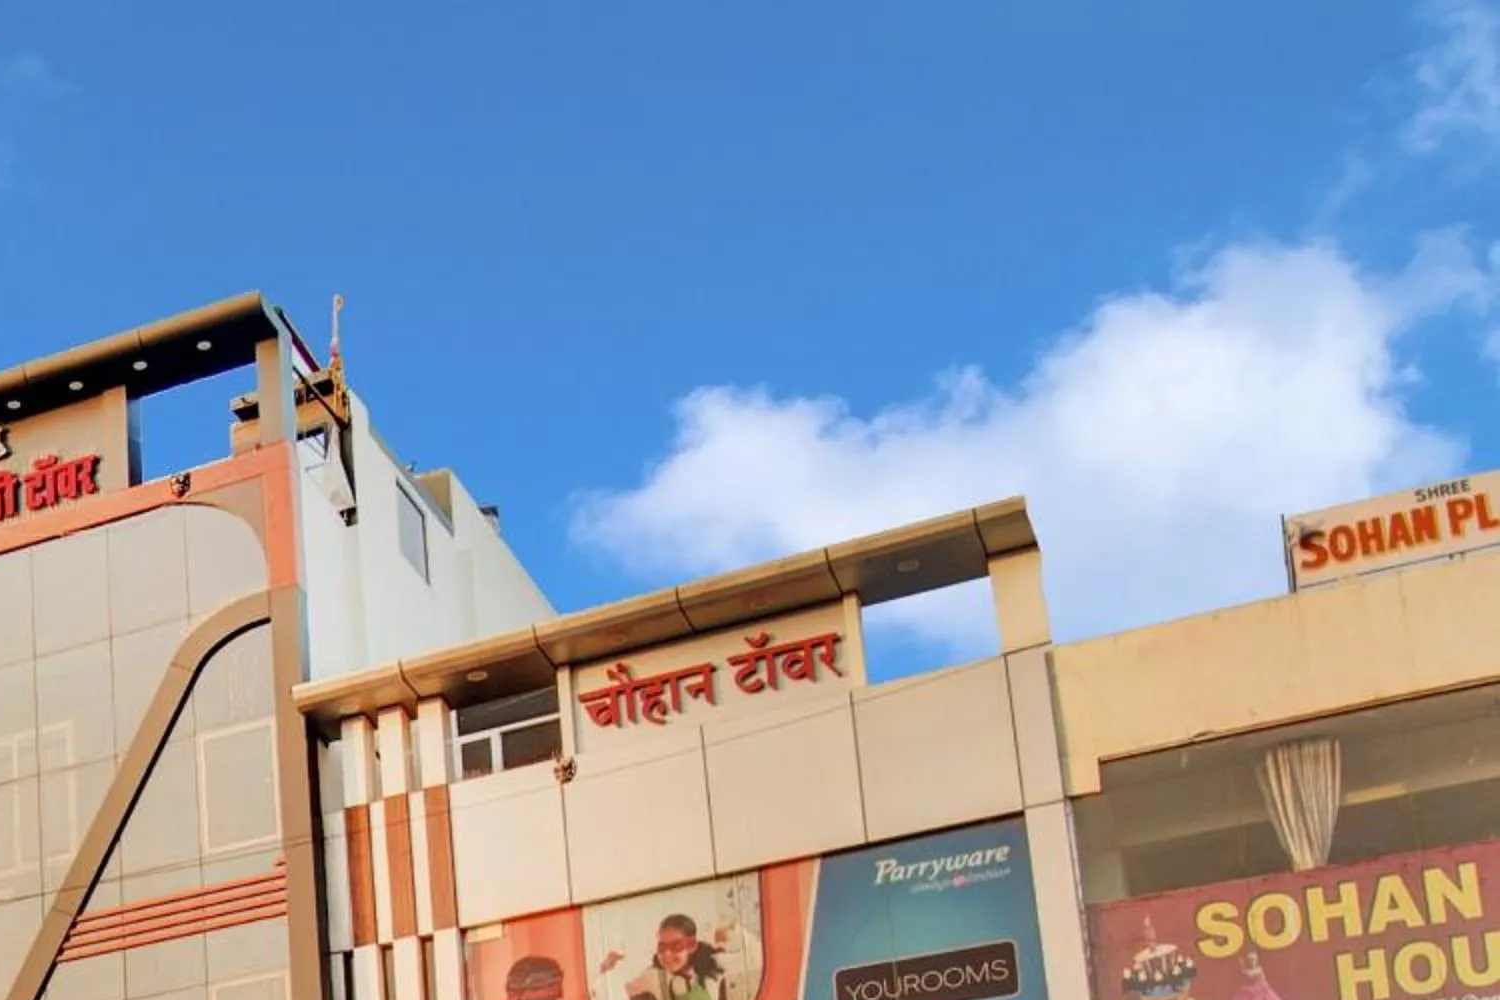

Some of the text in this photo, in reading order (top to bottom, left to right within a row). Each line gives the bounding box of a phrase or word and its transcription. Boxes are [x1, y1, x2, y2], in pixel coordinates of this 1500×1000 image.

[24, 454, 100, 512] टॉवर
[1414, 479, 1471, 502] SHREE
[1299, 492, 1500, 571] SOHAN PL
[579, 631, 842, 728] चौहान टॉवर
[873, 845, 1011, 886] Parryware
[1195, 862, 1483, 958] SOHAN
